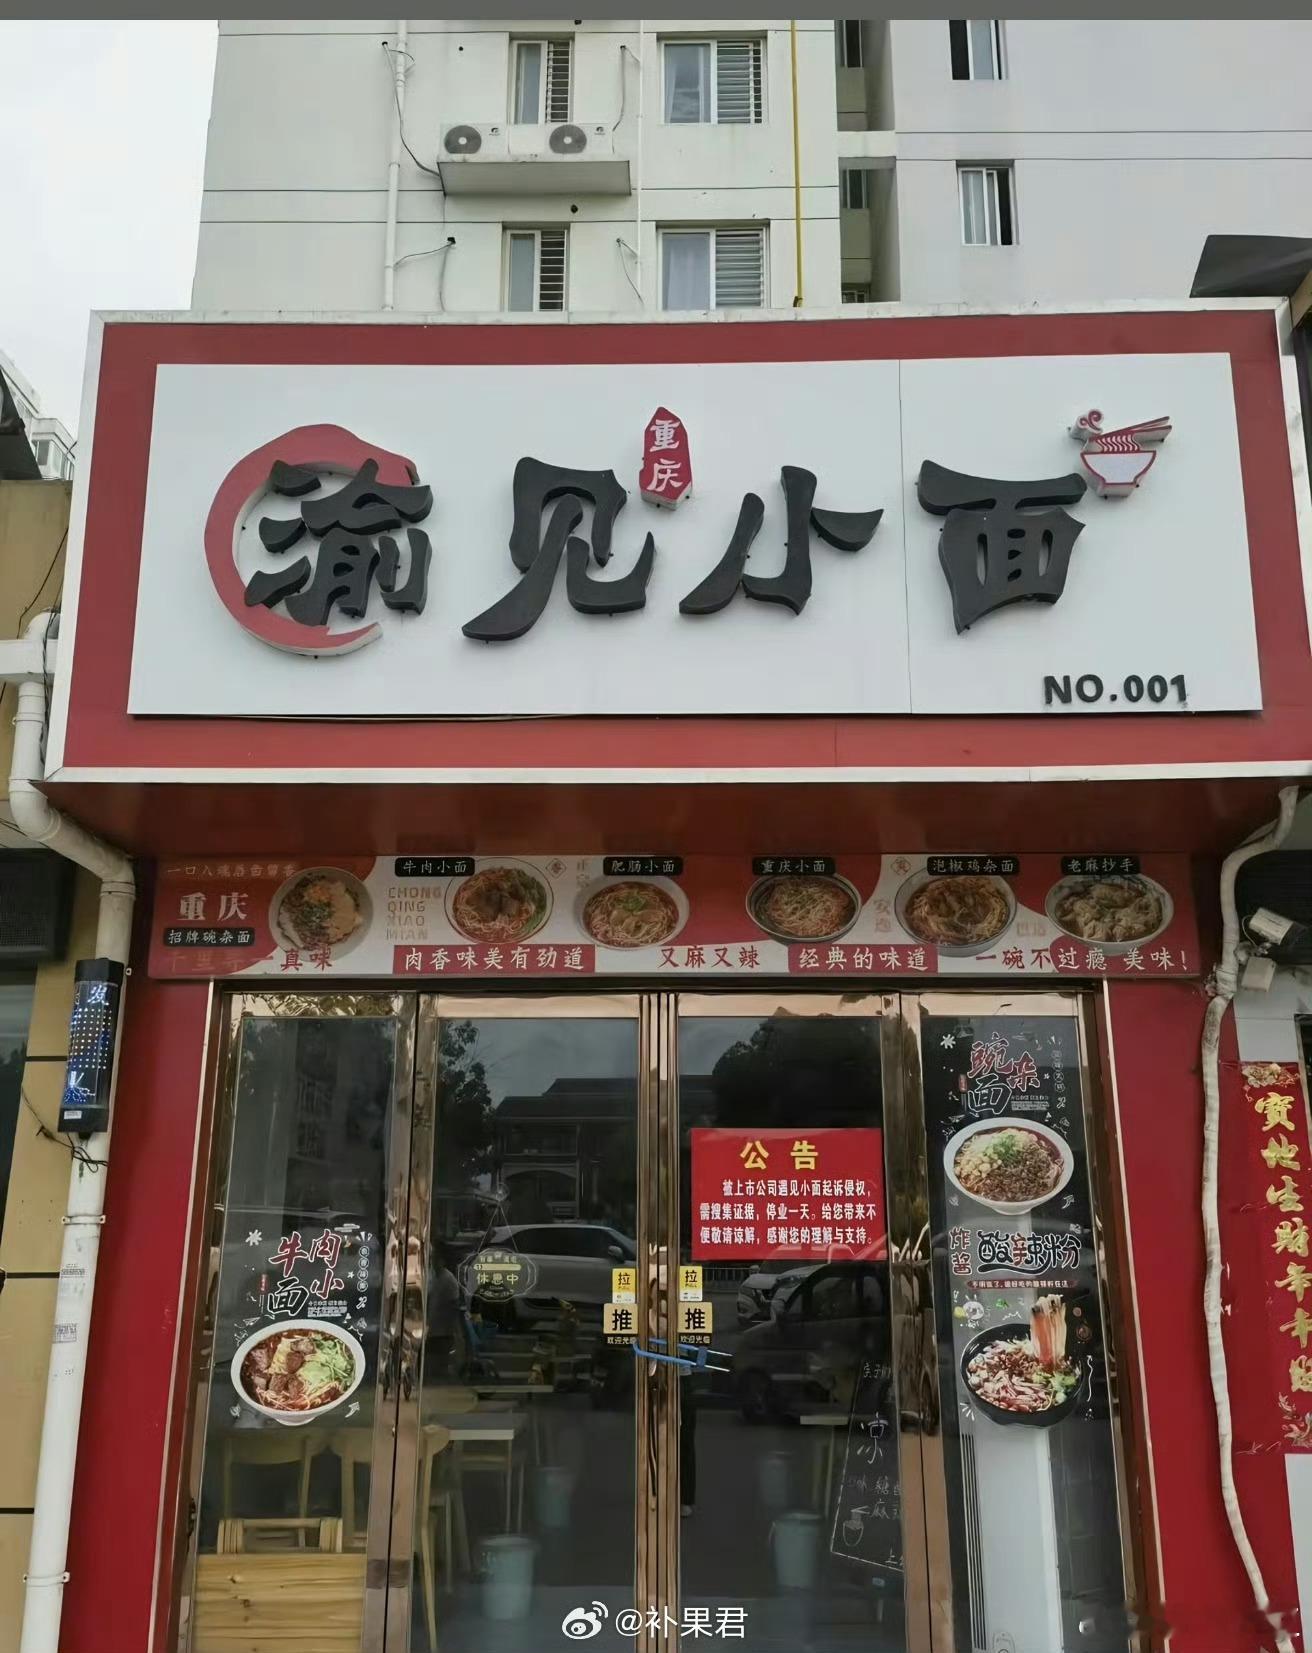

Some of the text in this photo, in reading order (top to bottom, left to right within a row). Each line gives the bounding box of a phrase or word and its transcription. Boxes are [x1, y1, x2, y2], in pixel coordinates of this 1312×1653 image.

[649, 419, 683, 492] 重庆
[244, 457, 1088, 641] 渝见小面
[1043, 674, 1189, 705] NO.001
[403, 860, 467, 875] 牛肉小面
[611, 860, 676, 873] 肥肠小面
[760, 859, 826, 873] 重庆小面
[933, 859, 1014, 873] 泡椒鸡杂面
[1067, 858, 1134, 873] 老麻抄手
[178, 891, 249, 921] 重庆
[387, 901, 426, 912] QING
[405, 946, 584, 971] 肉香味美有劲道
[657, 945, 761, 969] 又麻又辣
[799, 946, 929, 971] 经典的味道
[740, 1140, 819, 1170] 公告
[977, 1229, 1083, 1276] 酸辣粉
[477, 1272, 519, 1286] 休息中
[618, 1272, 631, 1286] 拉
[685, 1269, 698, 1283] 拉
[612, 1308, 633, 1331] 推
[685, 1307, 706, 1330] 推
